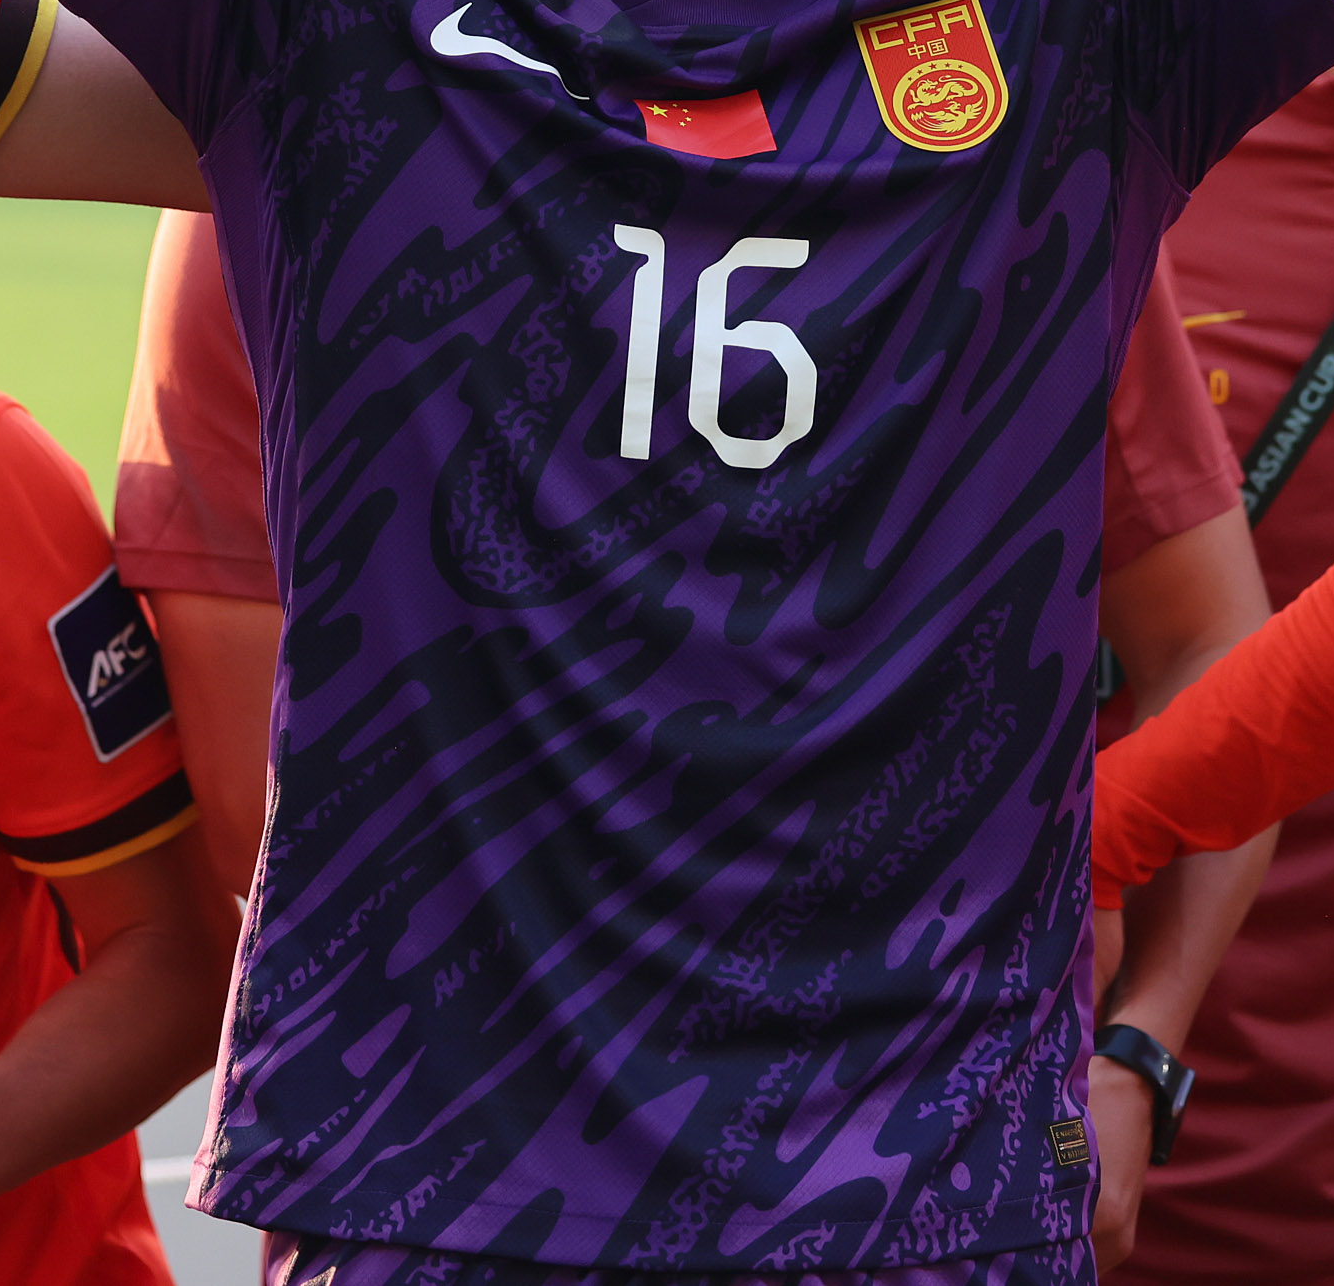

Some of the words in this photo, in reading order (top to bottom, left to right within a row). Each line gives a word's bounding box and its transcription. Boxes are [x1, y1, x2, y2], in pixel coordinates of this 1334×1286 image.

[868, 4, 974, 51] CFA
[907, 37, 949, 60] 中国
[613, 223, 818, 469] 16
[1249, 408, 1313, 493] ASIAN
[87, 621, 147, 698] AFC
